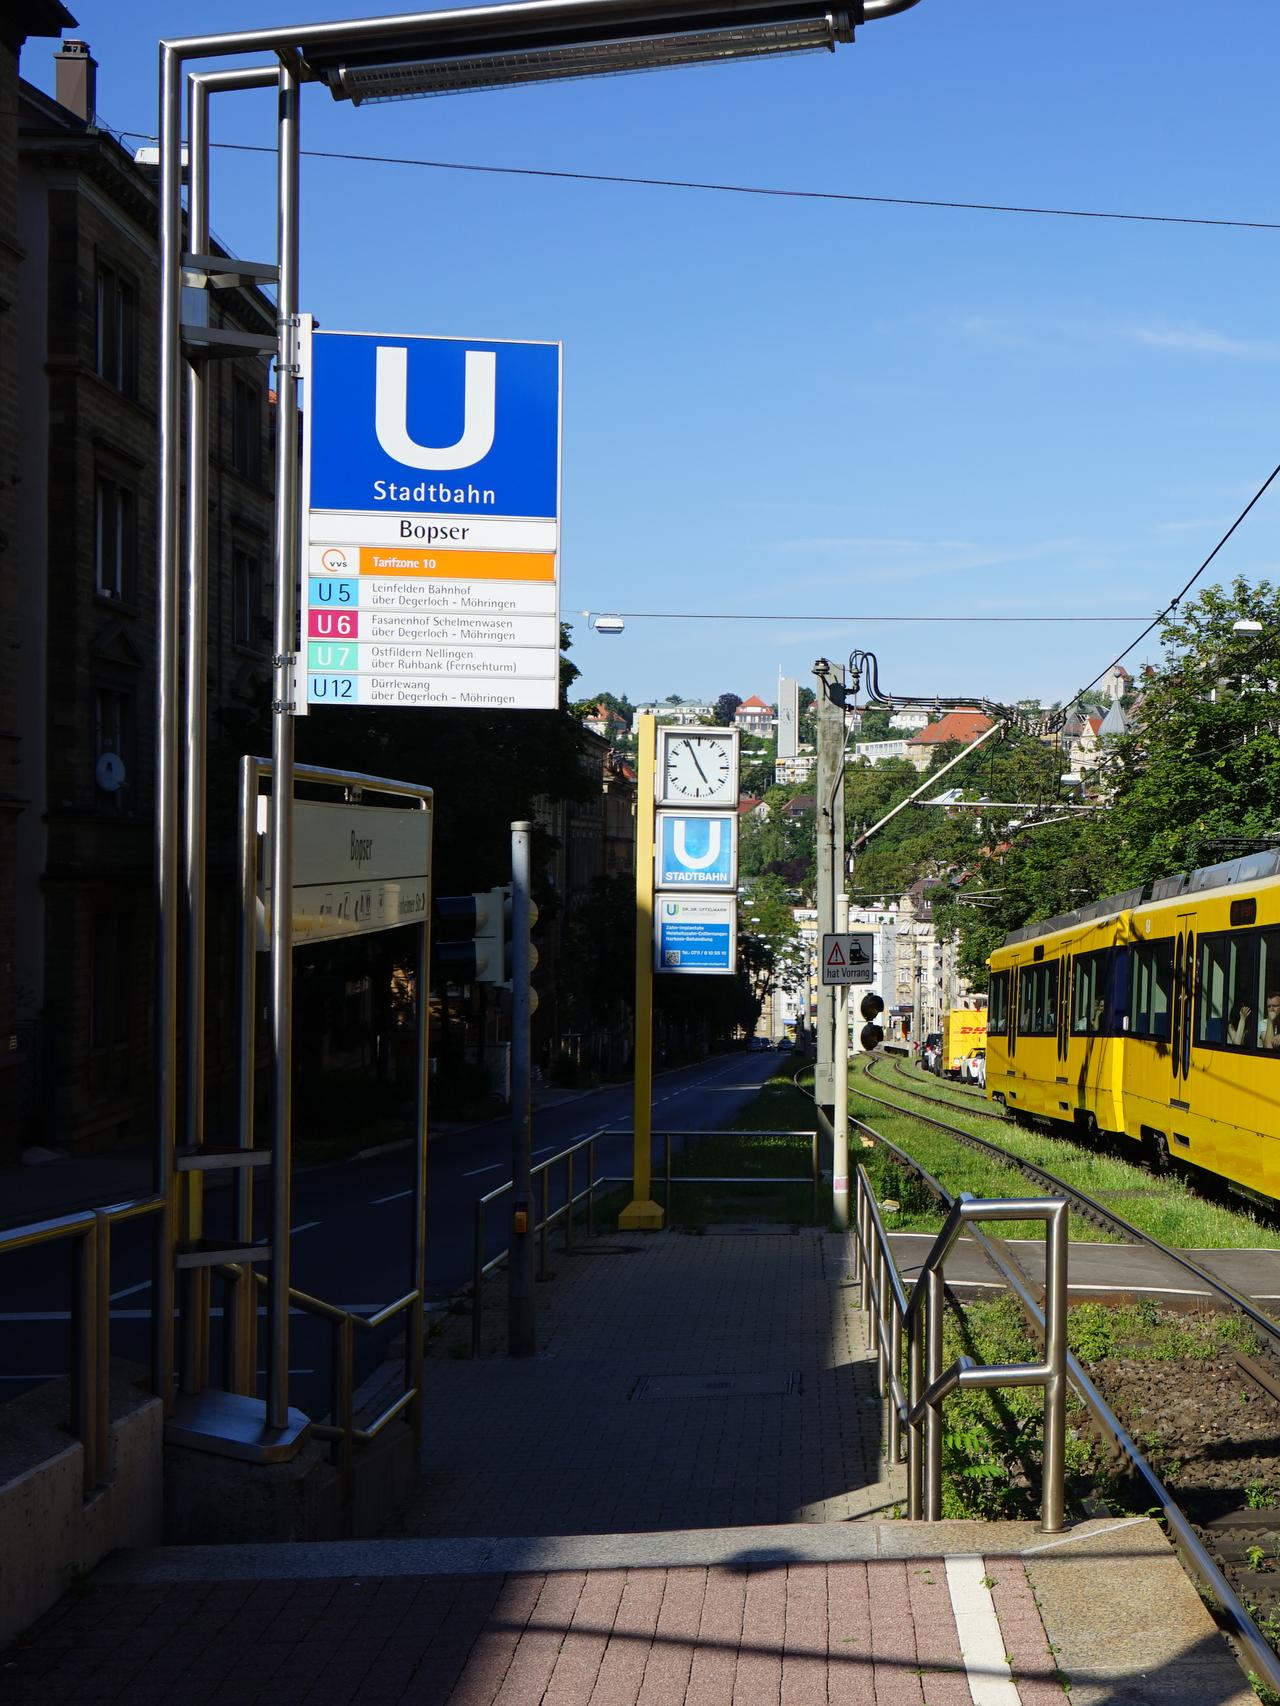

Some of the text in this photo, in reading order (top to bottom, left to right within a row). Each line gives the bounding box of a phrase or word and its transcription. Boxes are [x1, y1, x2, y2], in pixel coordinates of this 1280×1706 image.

[375, 346, 496, 471] U
[373, 480, 496, 504] Stadtbahn
[400, 520, 470, 544] Bopser
[372, 557, 436, 569] Tarifzone 10
[372, 583, 471, 595] Leinfelden Bahnhof
[372, 595, 394, 605] über
[398, 596, 449, 609] Degerloch
[460, 597, 516, 611] Möhringen
[372, 615, 513, 628] Fasanenhof Schelmenwasen
[372, 627, 394, 637] über
[398, 628, 448, 640] Degerloch
[460, 629, 515, 642] Möhringen
[372, 647, 473, 661] Ostfildern Nellingen
[371, 659, 517, 673] über Ruhbank (Fernsehturm)
[313, 678, 352, 698] U12
[371, 678, 430, 691] Dürrlewang
[371, 690, 394, 700] über
[397, 691, 448, 703] Degerloch
[460, 692, 515, 705] Möhringen
[350, 830, 373, 869] Bopser
[673, 820, 721, 869] U
[665, 871, 728, 882] STADTBAHN
[827, 968, 870, 980] hat Vorrang
